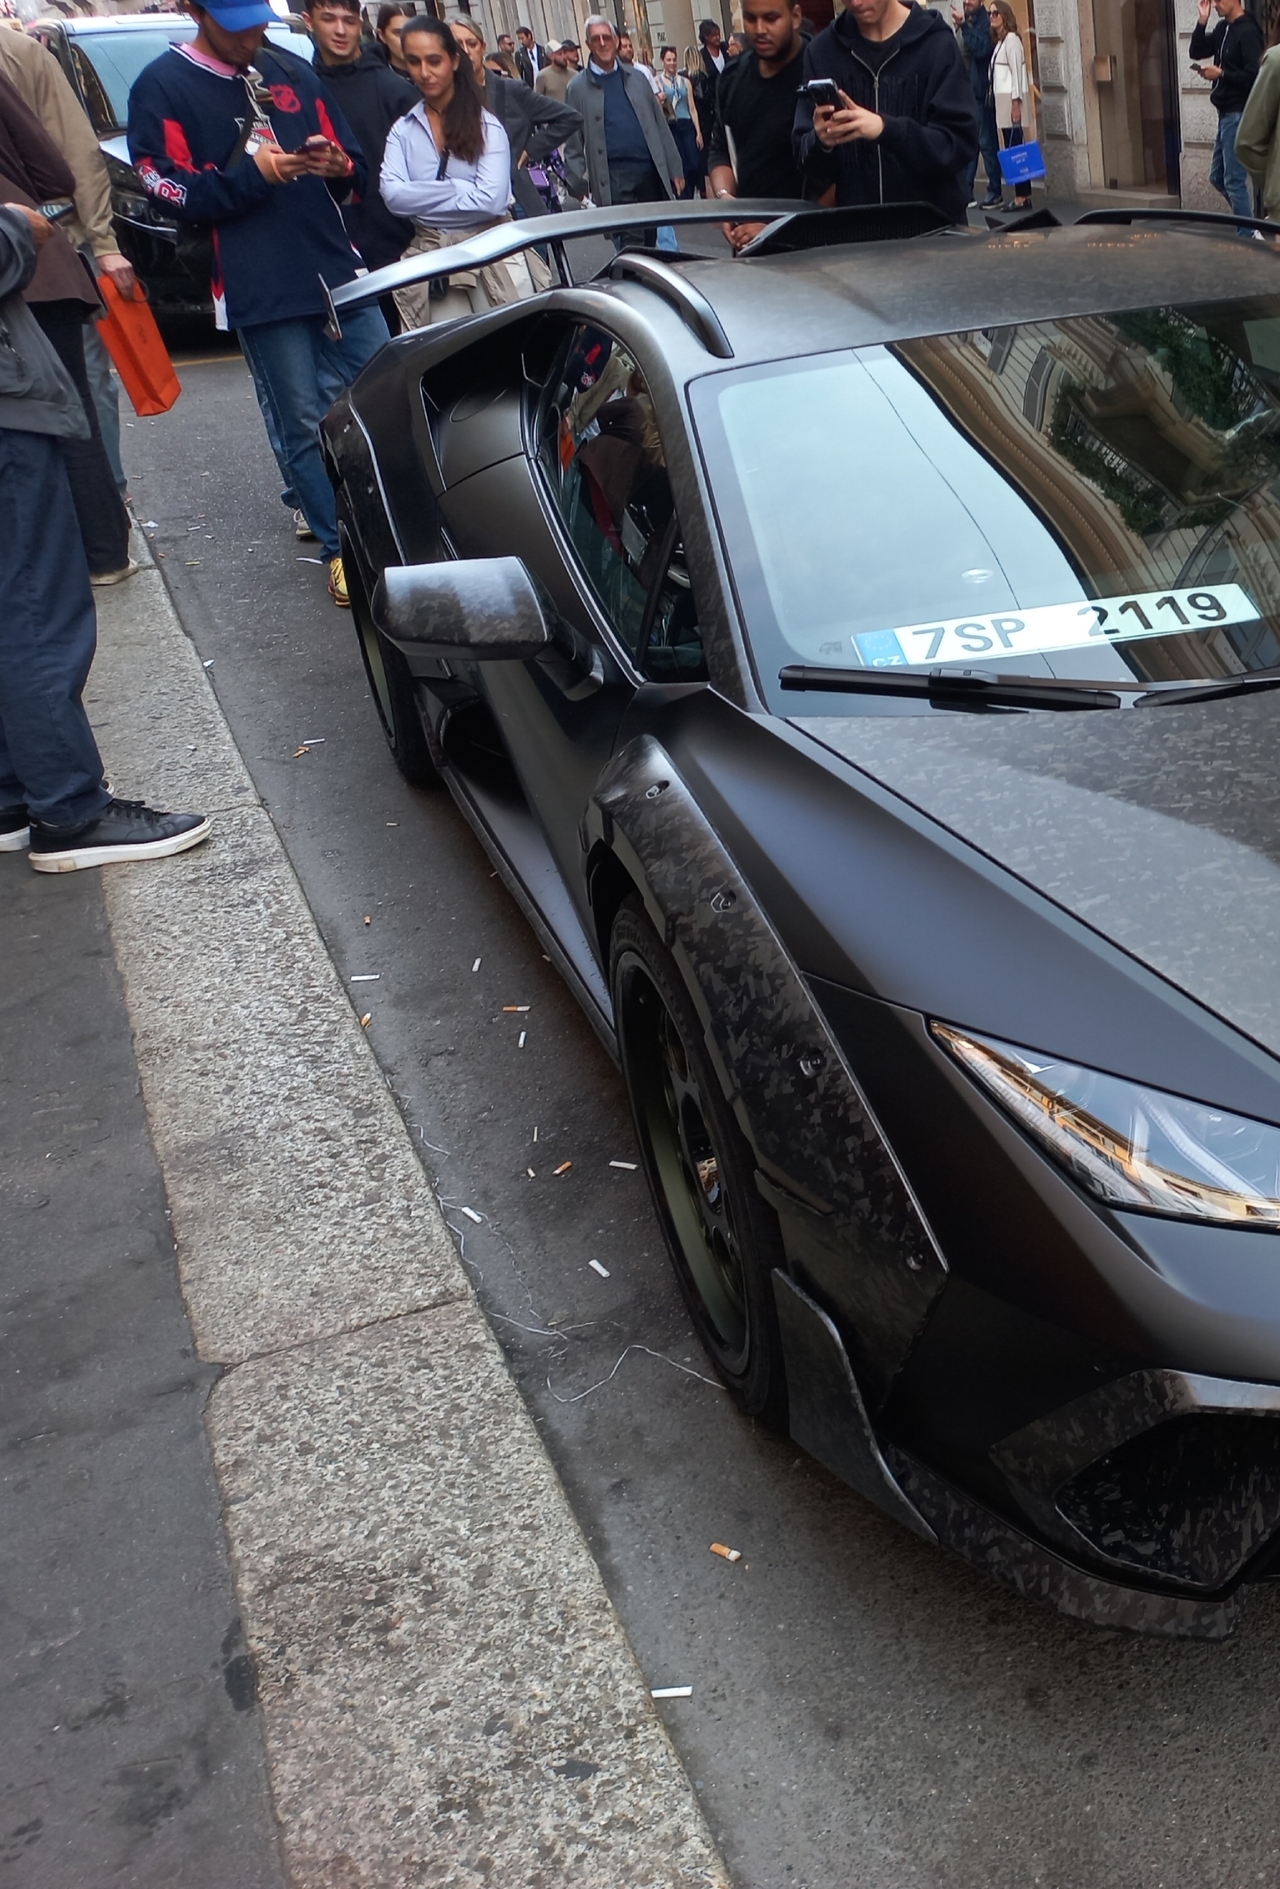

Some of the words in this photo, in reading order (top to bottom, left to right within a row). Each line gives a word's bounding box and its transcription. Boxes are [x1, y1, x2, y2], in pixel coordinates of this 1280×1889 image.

[911, 617, 1026, 660] 7SP
[1076, 592, 1228, 637] 2119
[871, 655, 903, 667] CZ
